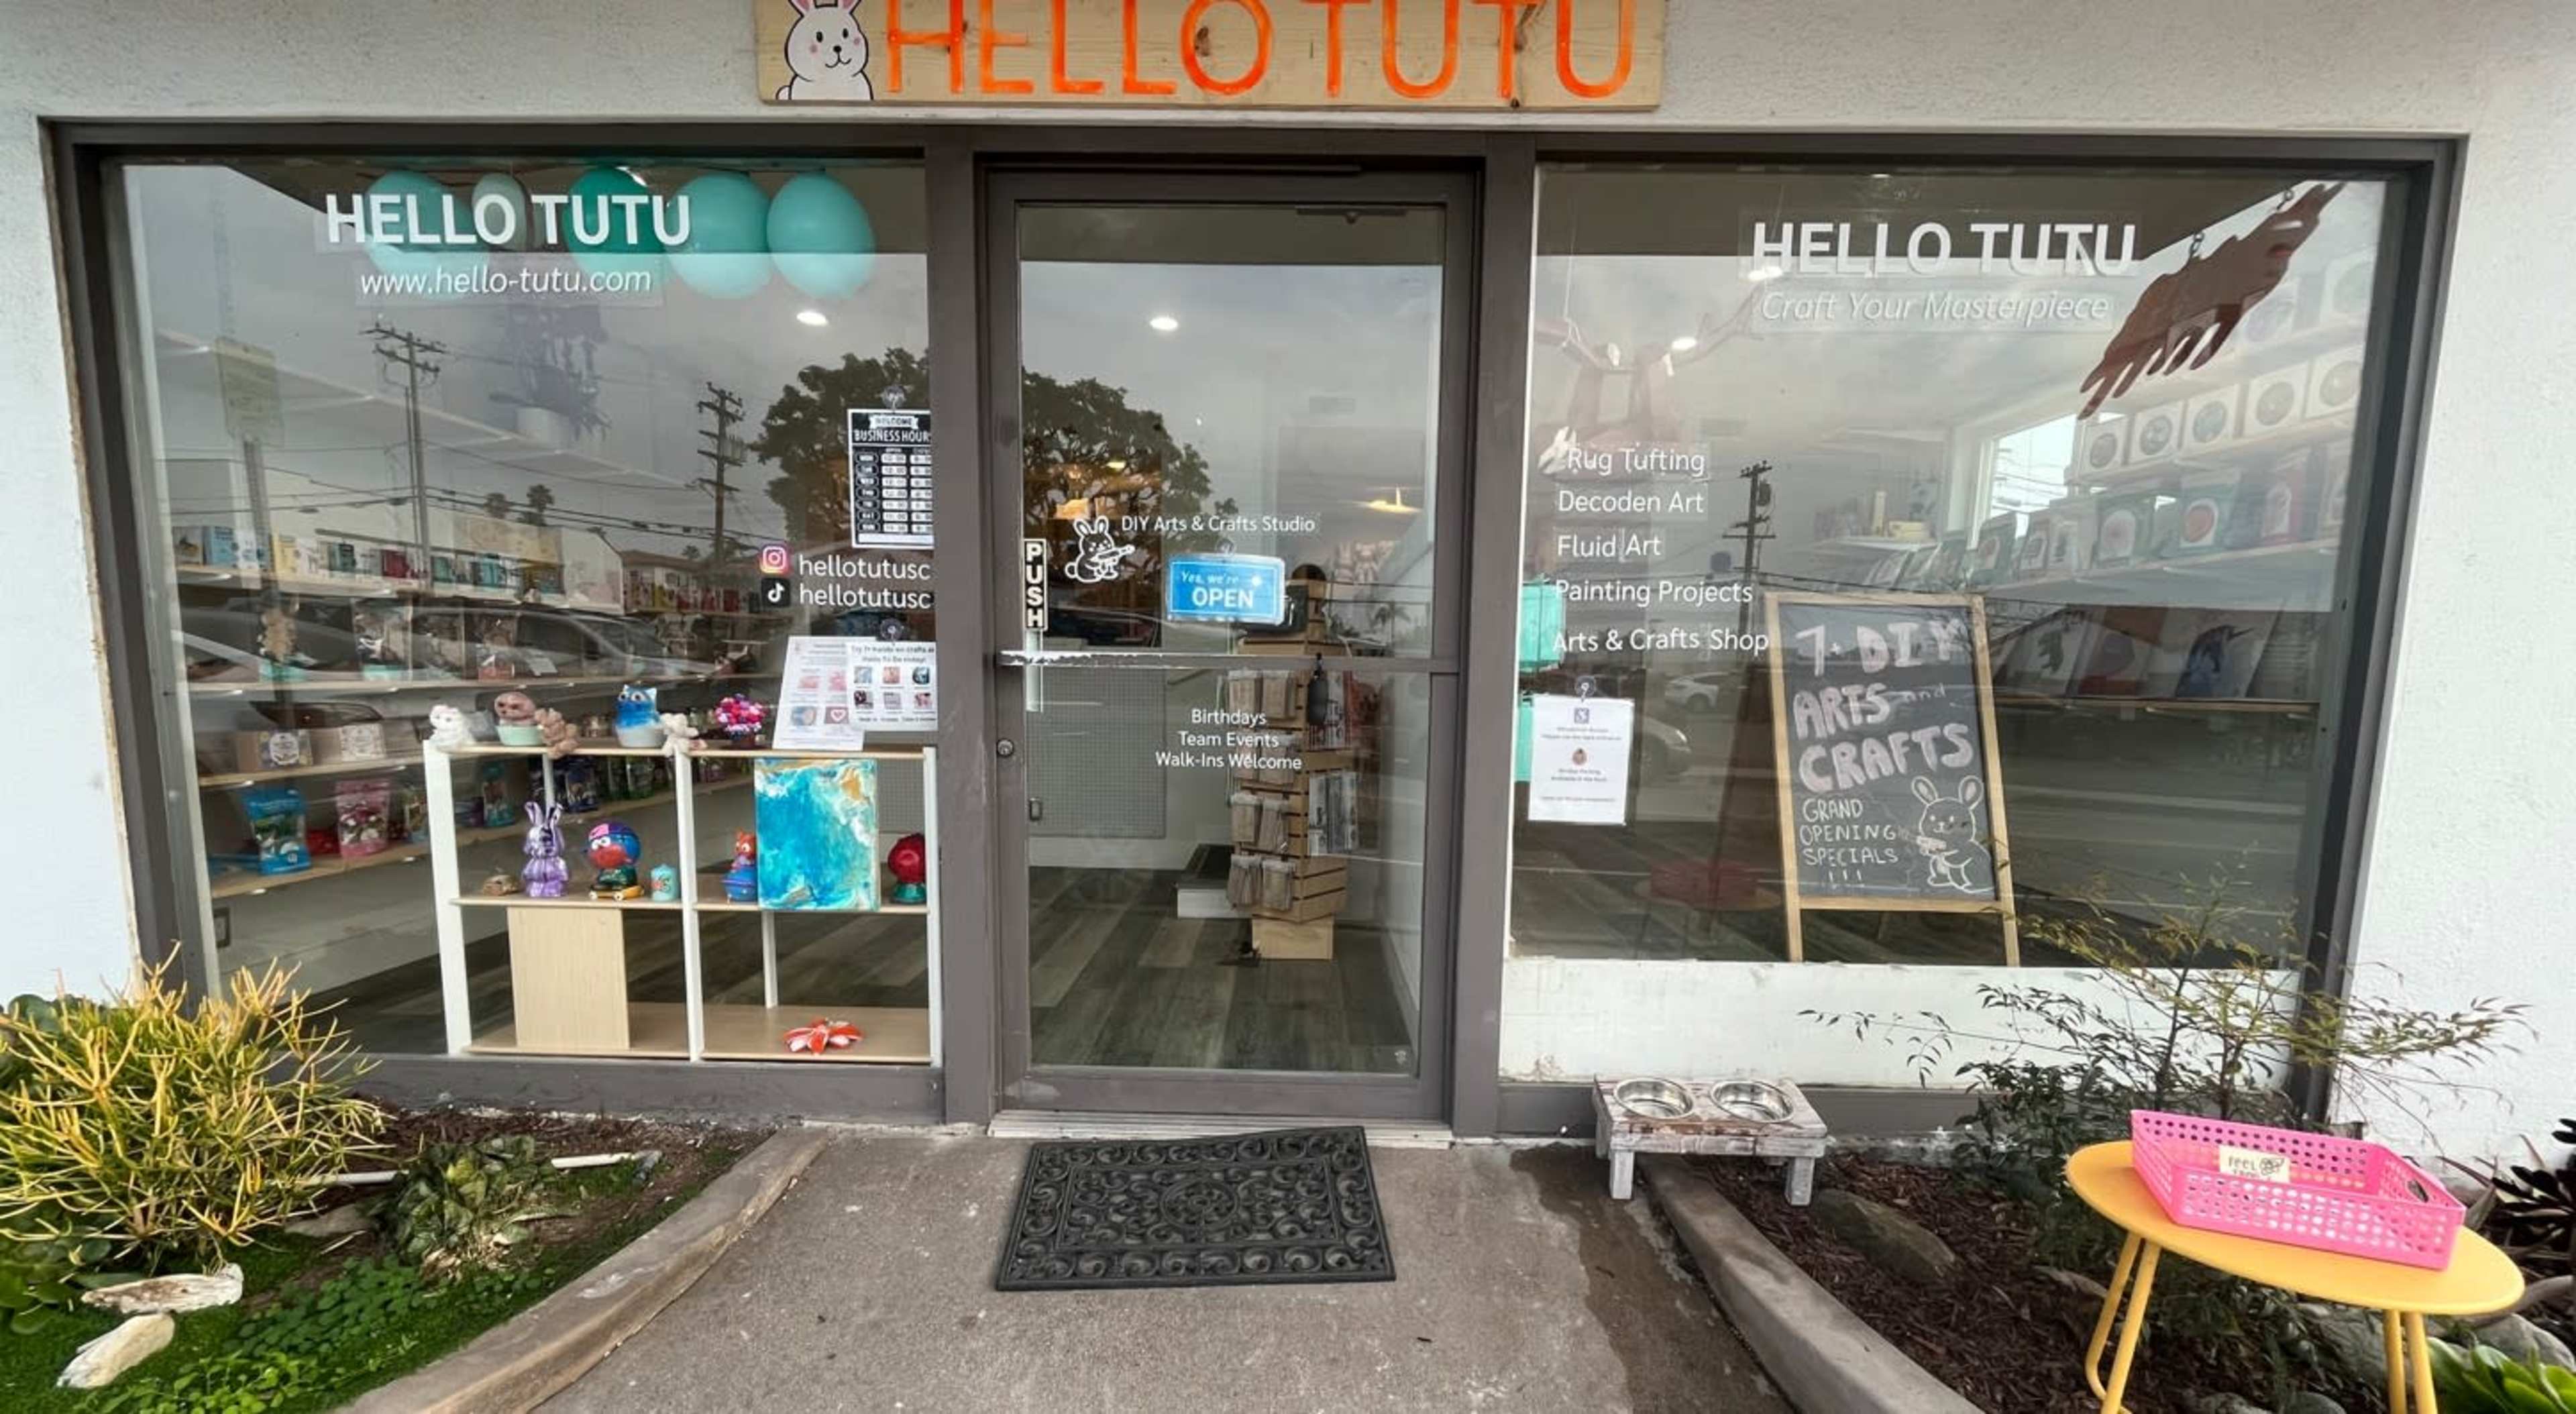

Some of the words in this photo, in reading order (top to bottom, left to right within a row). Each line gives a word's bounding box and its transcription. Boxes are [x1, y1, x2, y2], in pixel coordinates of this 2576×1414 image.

[886, 0, 1272, 95] HELLO
[1301, 0, 1633, 98] TUTU
[326, 194, 516, 244] HELLO
[531, 195, 690, 245] TUTU
[1753, 222, 1952, 275] HELLO
[1970, 223, 2136, 276] TUTU
[360, 266, 651, 294] www.hello-tutu.com
[1761, 291, 1837, 321] Craft
[1848, 292, 1912, 321] Your
[1923, 292, 2109, 328] Masterpiece
[853, 429, 900, 442] BUSINESS
[1567, 448, 1613, 476] Rug
[1620, 447, 1705, 476] Tufting
[1558, 490, 1661, 512] Decoden
[1668, 492, 1704, 513] Art
[1122, 516, 1151, 531] DIY
[1155, 516, 1187, 532] Arts
[1191, 517, 1204, 531] &
[1208, 516, 1258, 532] Crafts
[1262, 516, 1316, 532] Studio
[1557, 534, 1617, 557] Fluid
[1625, 535, 1662, 556] Art
[799, 554, 931, 580] hellotutusc
[799, 584, 932, 609] hellotutusc
[1026, 545, 1044, 629] PUSH
[1191, 588, 1254, 608] OPEN
[1555, 580, 1650, 607] Painting
[1658, 580, 1754, 607] Projects
[1552, 629, 1599, 651] Arts
[1606, 630, 1623, 651] &
[1629, 627, 1700, 651] Crafts
[1710, 628, 1769, 656] Shop
[1856, 617, 1971, 673] DIY
[1191, 708, 1267, 726] Birthdays
[1791, 683, 1892, 739] ARTS
[1902, 682, 1946, 703] and
[1178, 731, 1222, 746] Team
[1226, 731, 1279, 747] Events
[1155, 751, 1224, 768] Walk-Ins
[1228, 753, 1302, 769] Welcome
[1799, 722, 1974, 794] CRAFTS
[1802, 798, 1864, 824] GRAND
[1799, 824, 1897, 847] OPENING
[1803, 845, 1899, 868] SPECIALS
[1827, 870, 1864, 889] !!!
